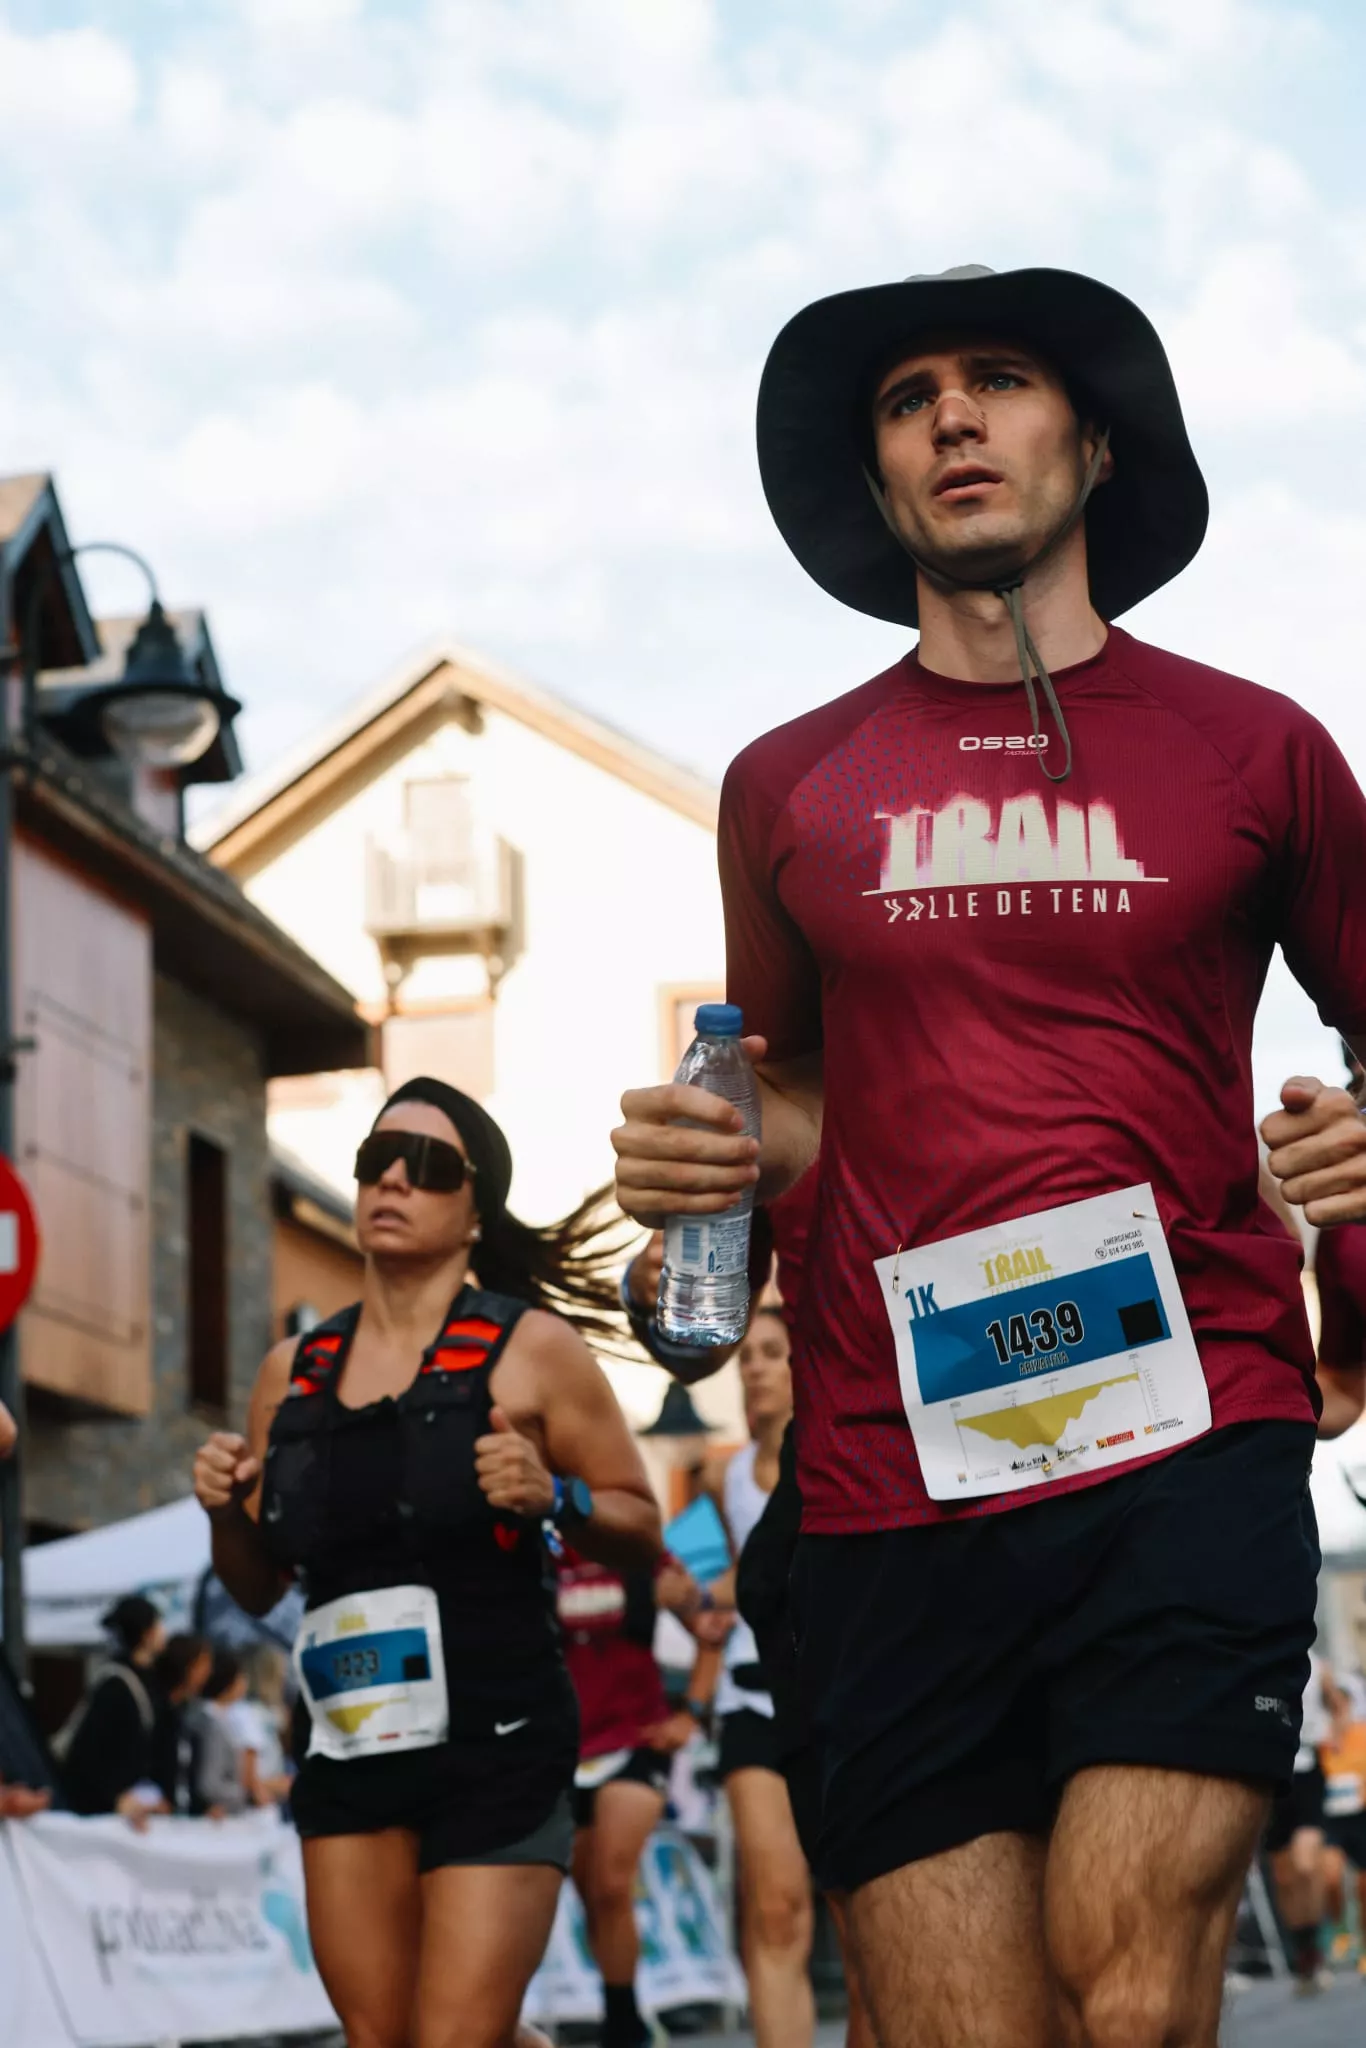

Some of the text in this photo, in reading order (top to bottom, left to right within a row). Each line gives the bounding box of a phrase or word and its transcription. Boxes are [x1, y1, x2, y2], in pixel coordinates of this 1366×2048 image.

[873, 788, 1146, 890] TRAIL
[996, 889, 1032, 916] DE
[1050, 888, 1131, 914] TENA
[979, 1246, 1053, 1288] TRAIL
[905, 1282, 940, 1319] 1K
[985, 1301, 1085, 1365] 1439
